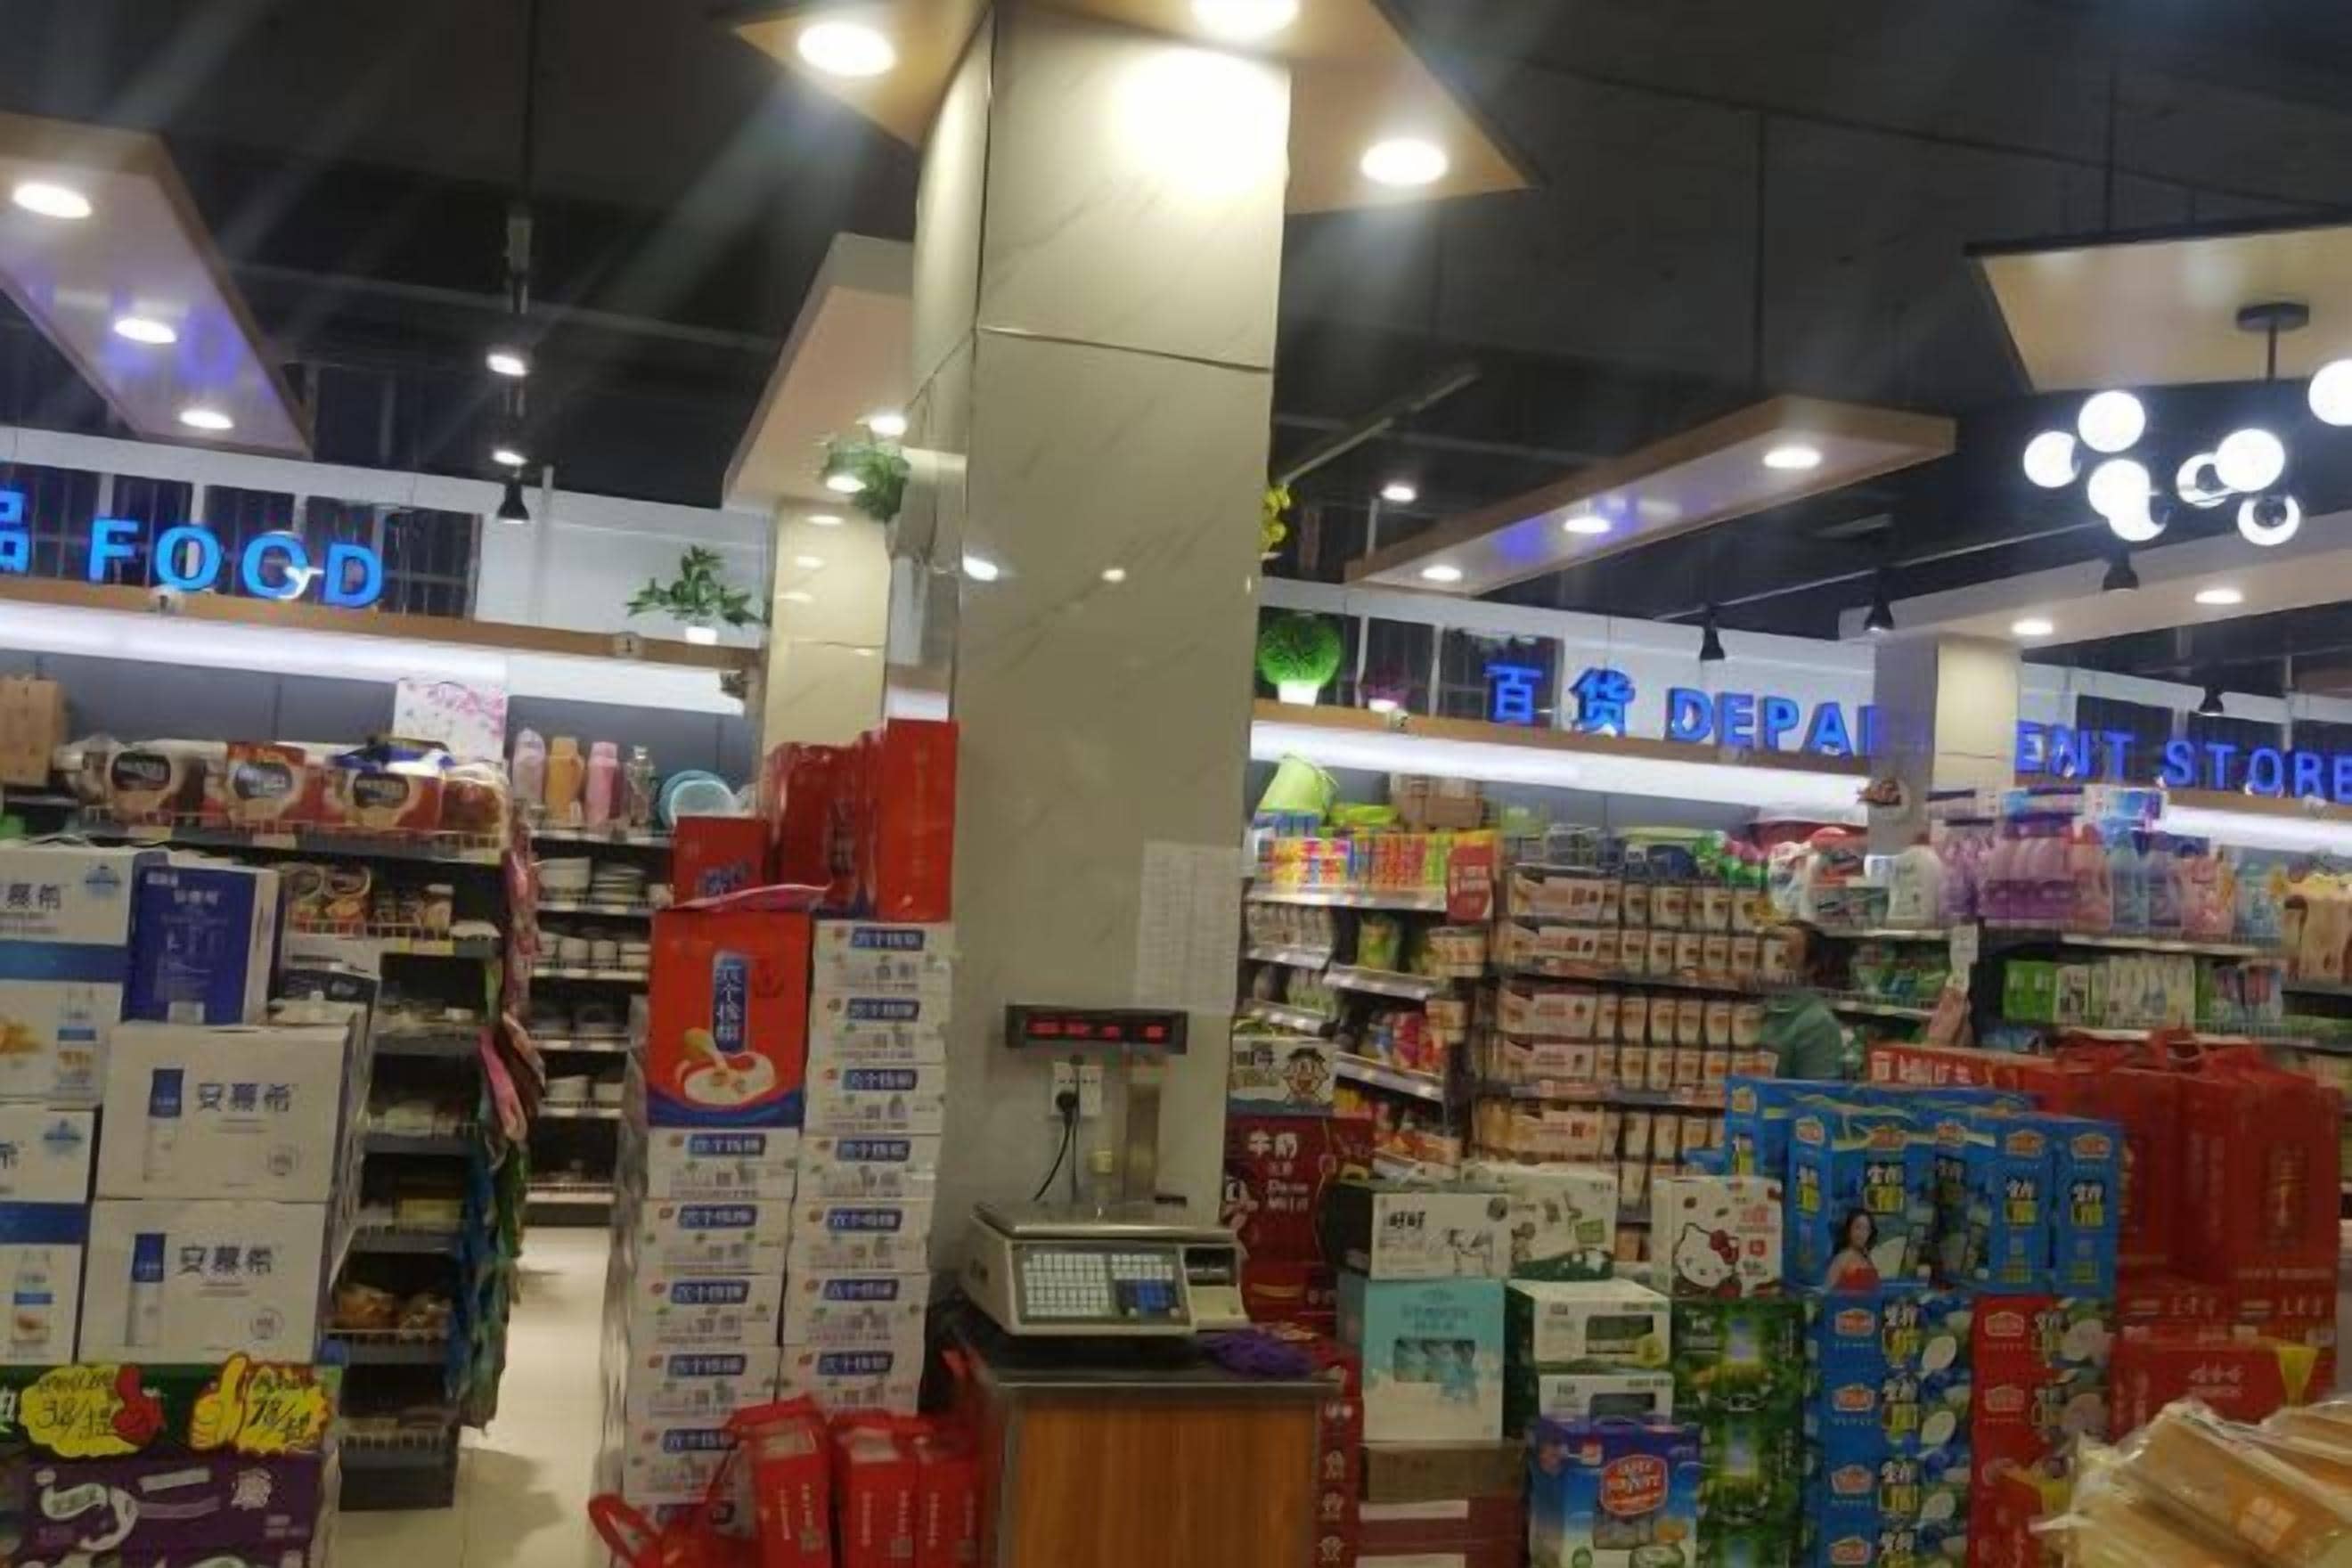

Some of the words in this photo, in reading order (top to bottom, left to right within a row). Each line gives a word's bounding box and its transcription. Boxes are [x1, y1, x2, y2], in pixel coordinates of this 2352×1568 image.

[88, 514, 387, 610] FOOD
[1482, 660, 1636, 739] 百货
[2162, 738, 2352, 805] STORE
